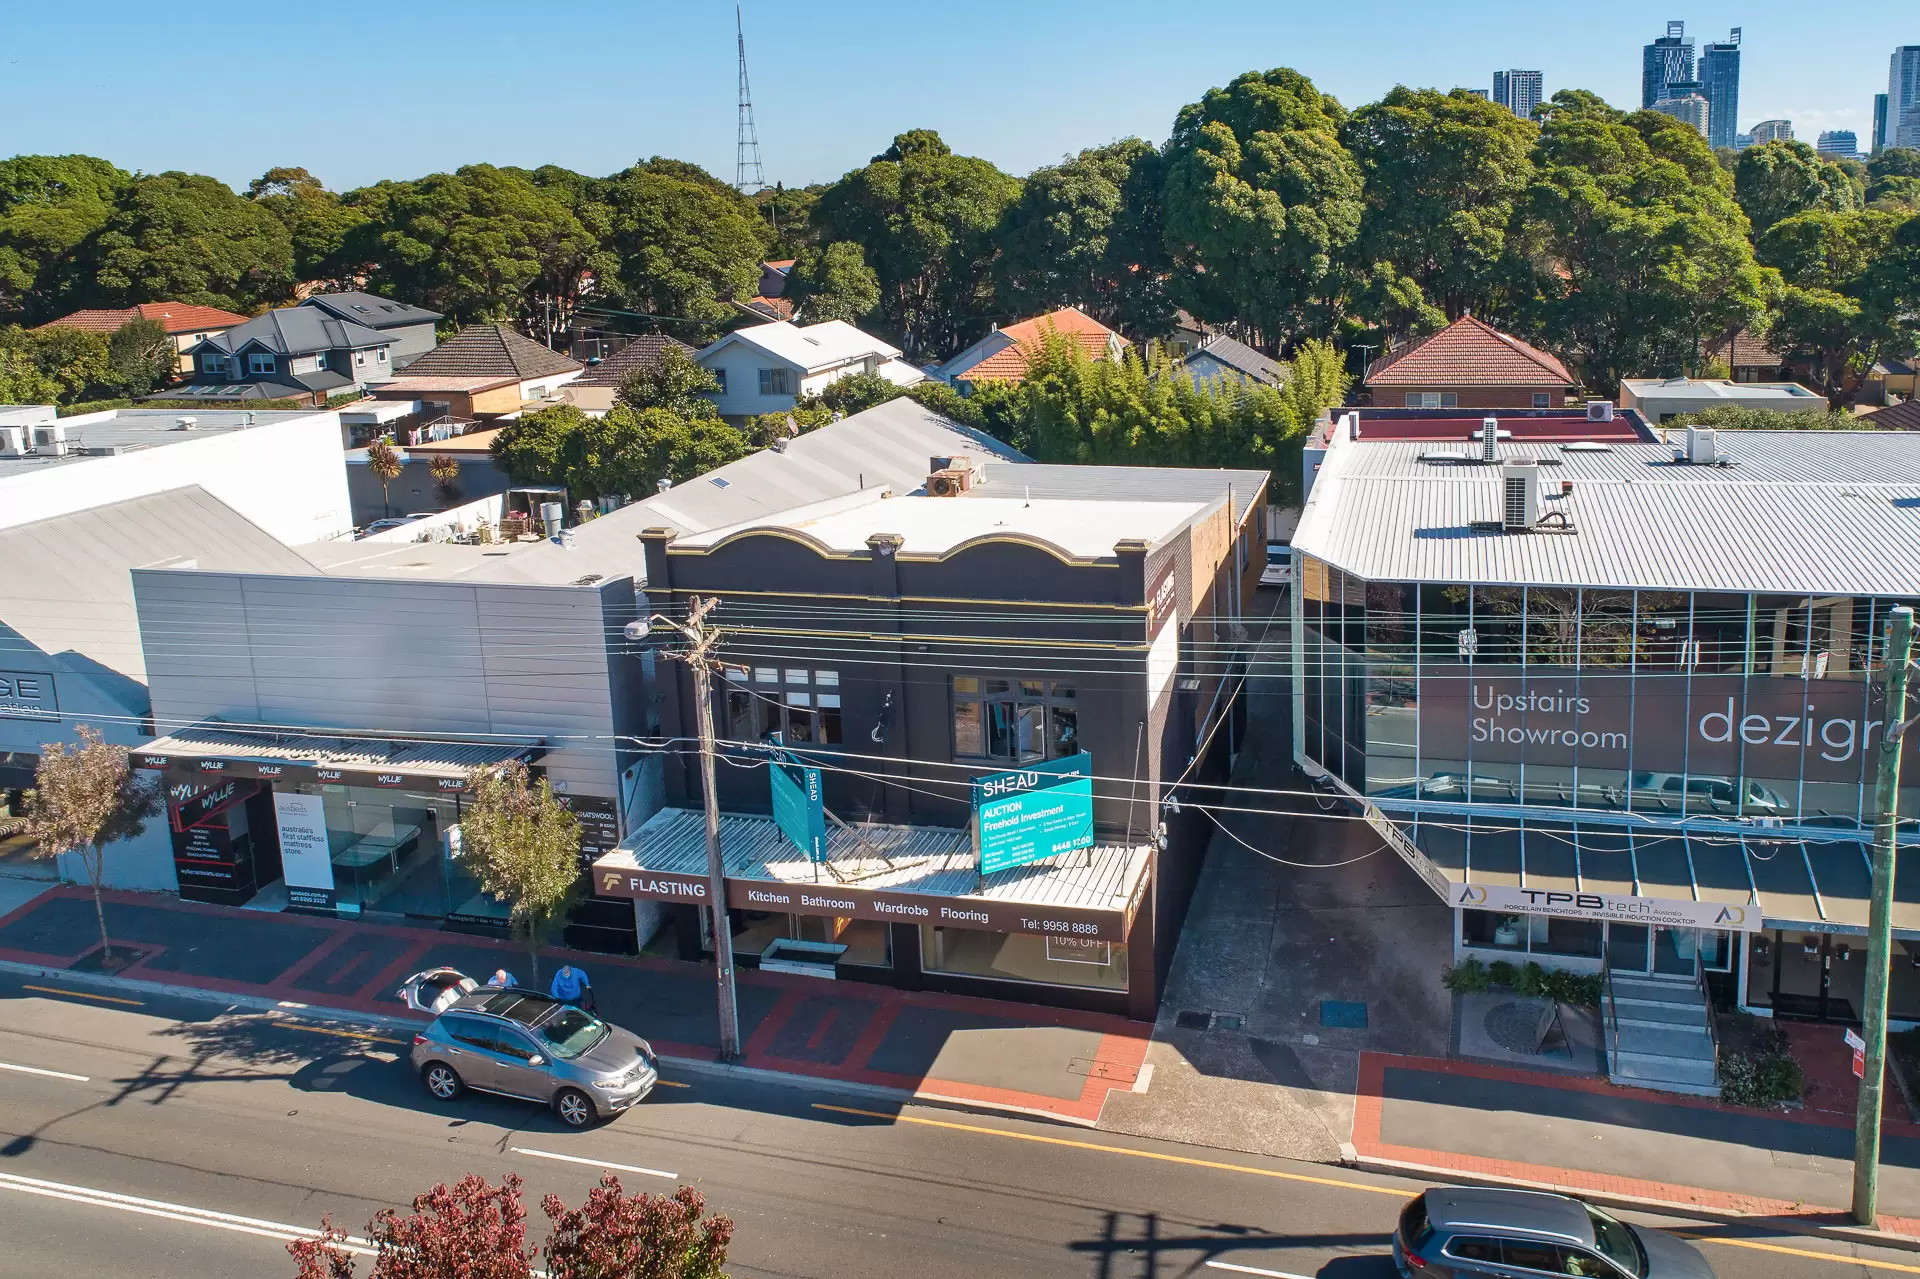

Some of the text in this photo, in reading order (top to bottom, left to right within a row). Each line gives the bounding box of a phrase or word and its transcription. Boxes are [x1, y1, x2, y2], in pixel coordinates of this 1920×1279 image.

[1473, 685, 1591, 717] Upstairs
[1472, 718, 1628, 749] Showroom
[145, 756, 168, 765] WYLLIE
[201, 761, 223, 770] WYLLIE
[258, 766, 282, 775] WYLLIE
[318, 770, 341, 779] WYLLIE
[378, 775, 402, 783] WYLLIE
[439, 780, 463, 788] WYLLIE
[983, 772, 1038, 797] SHEAD
[809, 772, 818, 801] SHEAD
[984, 801, 1022, 819] AUCTION
[984, 814, 1019, 832] Freehold
[1021, 805, 1064, 822] Investment
[281, 826, 314, 836] australia's
[282, 832, 296, 840] first
[283, 840, 312, 849] mattress
[630, 878, 706, 897] FLASTING
[748, 890, 790, 904] Kitchen
[801, 894, 856, 910] Bathroom
[873, 901, 929, 916] Wardrobe
[941, 907, 989, 924] Flooring
[1020, 918, 1040, 930] Tel:
[1043, 920, 1069, 932] 9958
[1072, 922, 1098, 935] 8886
[1521, 890, 1604, 909] TPB
[1504, 904, 1542, 912] PORCELAIN
[1543, 906, 1583, 916] BENCHTOPS
[1624, 914, 1662, 922] INDUCTION
[1662, 917, 1696, 925] COOKTOP
